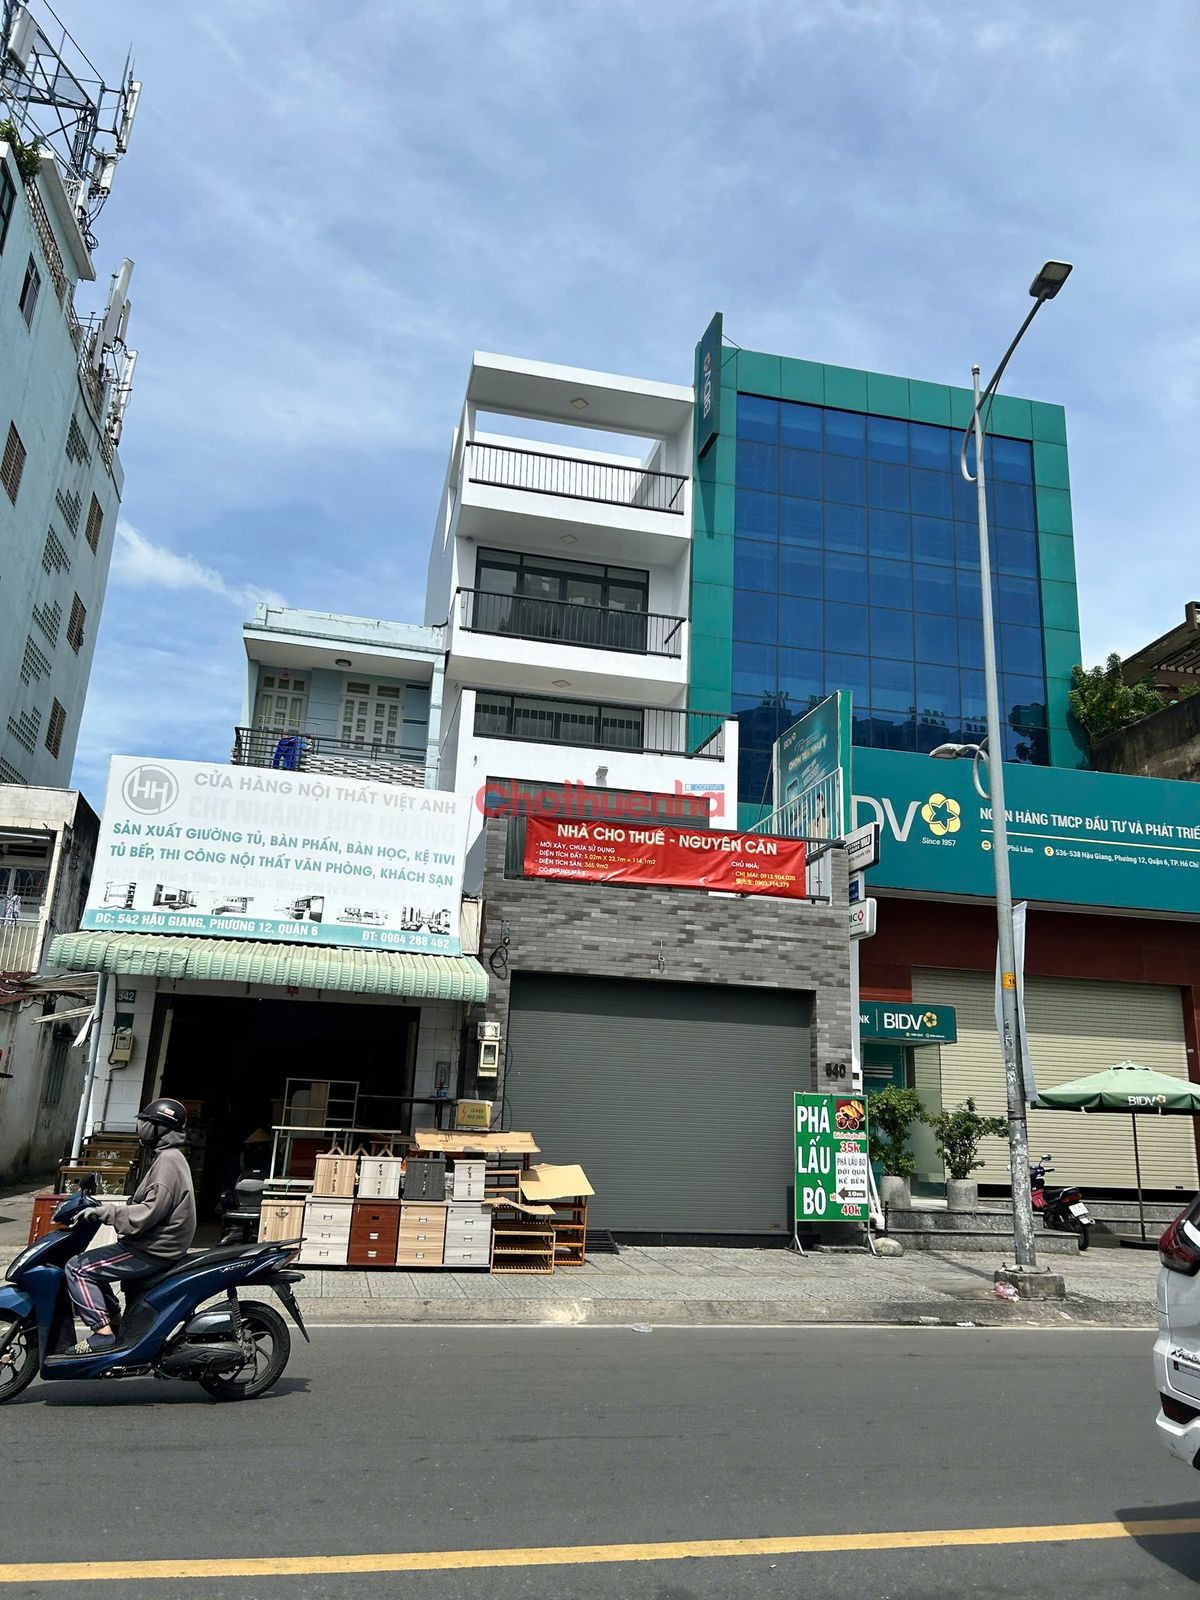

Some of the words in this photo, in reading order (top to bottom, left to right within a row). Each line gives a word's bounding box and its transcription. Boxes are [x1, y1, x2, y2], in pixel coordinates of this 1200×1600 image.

[194, 770, 233, 789] CỬA
[240, 776, 292, 794] HÀNG
[298, 782, 330, 801] NỘI
[336, 786, 378, 805] THẤT
[383, 793, 416, 812] VIỆT
[420, 800, 456, 814] ANH
[851, 794, 922, 841] DV
[1016, 810, 1048, 825] HÀNG
[1050, 814, 1082, 829] TMCP
[1085, 815, 1109, 832] ĐẦU
[1111, 820, 1128, 832] TƯ
[1129, 820, 1144, 834] VÀ
[1145, 822, 1173, 837] PHÁT
[113, 820, 142, 835] SẢN
[145, 822, 182, 838] XUẤT
[186, 827, 242, 843] GIƯỜNG
[247, 830, 265, 848] TỦ,
[270, 834, 298, 848] BÀN
[302, 836, 341, 854] PHẤN,
[346, 841, 373, 855] BÀN
[377, 846, 410, 862] HỌC,
[415, 849, 429, 865] KỆ
[433, 852, 455, 865] TIVI
[593, 827, 626, 842] CHO
[628, 828, 666, 845] THUÊ
[679, 834, 742, 852] NGUYÊN
[745, 839, 777, 856] CĂN
[922, 837, 940, 846] Since
[111, 845, 125, 857] TỦ
[130, 842, 154, 860] BẾP,
[160, 848, 180, 860] THI
[184, 848, 226, 863] CÔNG
[230, 852, 254, 868] NỘI
[259, 854, 291, 869] THẤT
[295, 858, 322, 872] VĂN
[326, 861, 375, 879] PHÒNG,
[380, 868, 425, 883] KHÁCH
[429, 874, 453, 888] SẠN
[1082, 852, 1094, 860] Hậu
[1095, 853, 1114, 863] Giang,
[1138, 856, 1147, 865] 12,
[1148, 857, 1163, 866] Quận
[1164, 859, 1169, 867] 6,
[95, 913, 114, 923] ĐC:
[117, 913, 139, 924] 542
[142, 914, 166, 928] HẬU
[168, 917, 206, 929] GIANG,
[259, 922, 274, 933] 12,
[278, 924, 308, 937] QUẬN
[311, 926, 318, 936] 6
[363, 931, 378, 941] ĐT:
[381, 932, 406, 944] 0964
[409, 935, 428, 946] 288
[884, 1012, 923, 1030] BIDV
[826, 1063, 846, 1079] 540
[1128, 1096, 1156, 1106] BIDV
[797, 1099, 830, 1133] PHÁ
[798, 1136, 830, 1174] LẤU
[841, 1142, 860, 1153] 35k
[803, 1180, 826, 1215] BÒ
[842, 1205, 860, 1215] 40k
